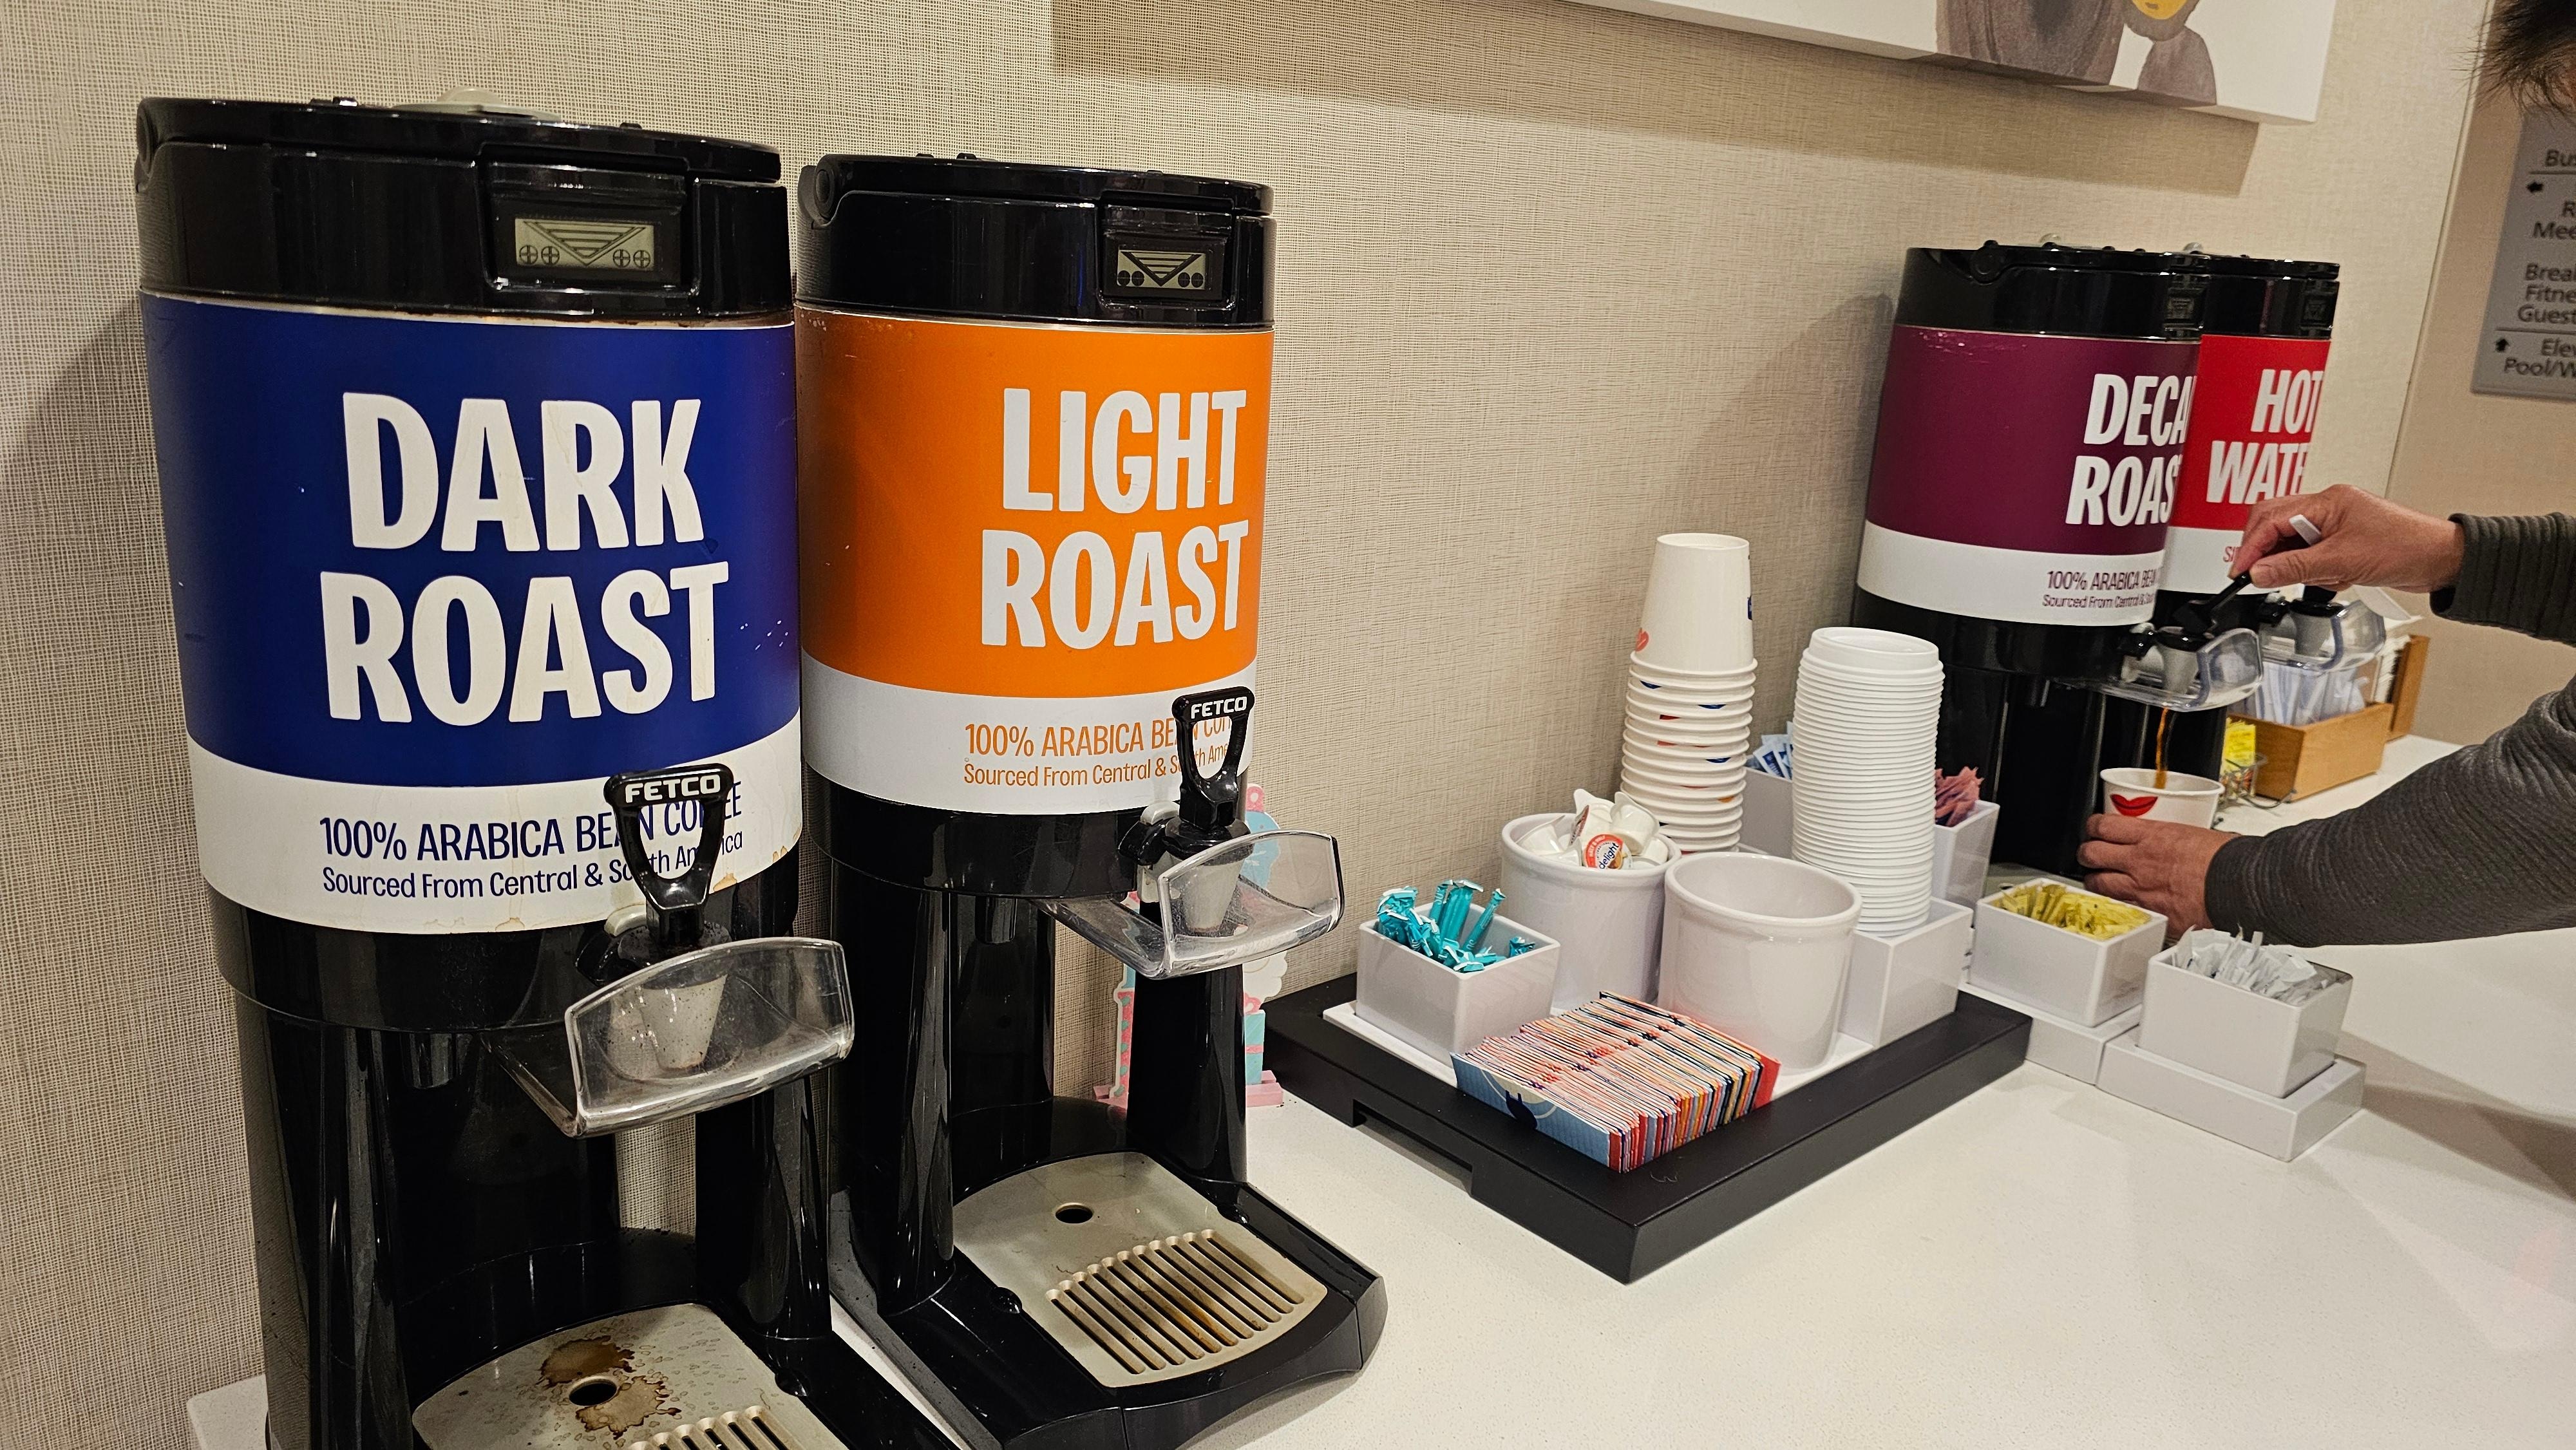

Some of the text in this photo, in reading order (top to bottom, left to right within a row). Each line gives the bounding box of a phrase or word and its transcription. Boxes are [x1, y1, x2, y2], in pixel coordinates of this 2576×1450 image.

[2525, 262, 2576, 282] Brea
[2084, 373, 2197, 446] DECA
[343, 392, 704, 551] DARK
[1003, 388, 1246, 513] LIGHT
[2065, 455, 2183, 526] ROAS
[982, 520, 1248, 649] ROAST
[2047, 570, 2088, 590] 100%
[2090, 571, 2140, 590] ARABICA
[321, 561, 728, 726] ROAST
[1191, 696, 1247, 719] FETCO
[965, 724, 1034, 757] 100%
[1041, 722, 1144, 757] ARABICA
[625, 775, 721, 804] FETCO
[964, 764, 1038, 786] Sourced
[1044, 767, 1088, 786] From
[1093, 759, 1151, 784] Central
[1155, 757, 1166, 777] &
[319, 817, 407, 861] 100%
[417, 818, 565, 861] ARABICA
[576, 805, 654, 853] BEN
[1598, 842, 1620, 869] delight
[323, 867, 415, 898] Sourced
[422, 874, 484, 898] From
[489, 865, 578, 897] Central
[584, 862, 603, 887] &
[609, 850, 670, 883] Soth
